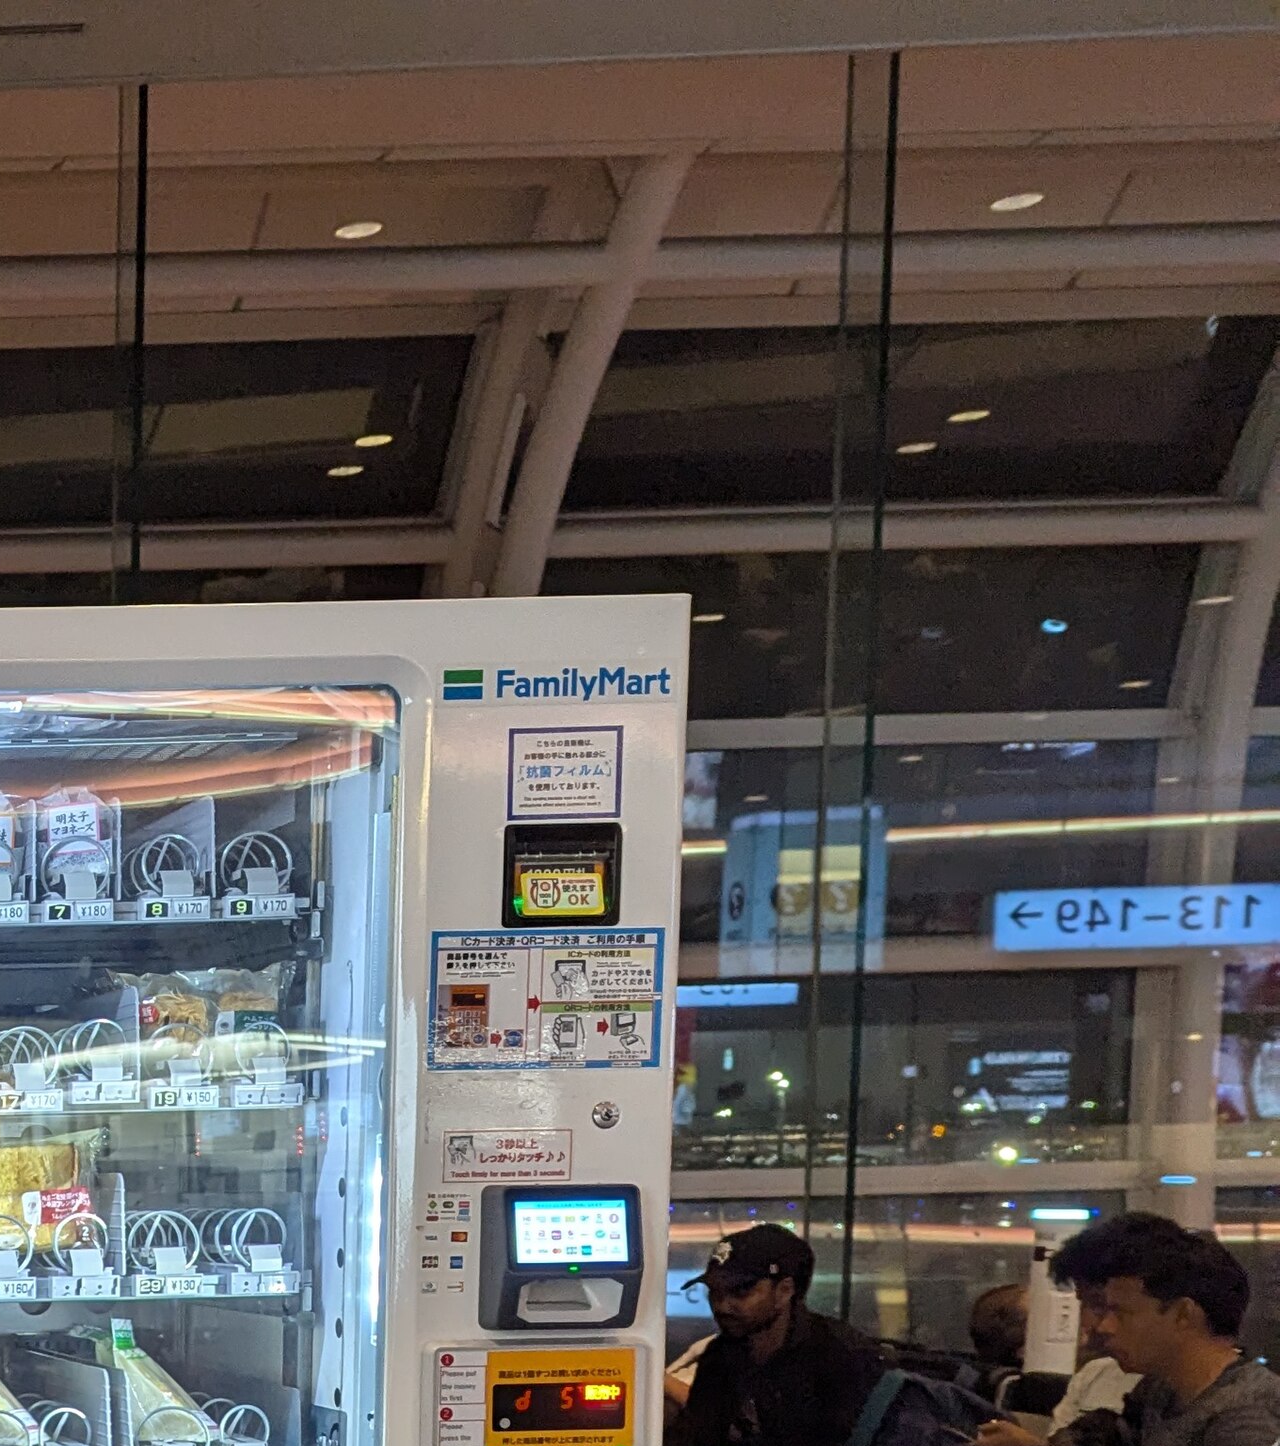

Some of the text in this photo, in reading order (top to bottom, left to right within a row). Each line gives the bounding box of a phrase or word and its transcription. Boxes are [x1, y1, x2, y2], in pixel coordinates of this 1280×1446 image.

[497, 667, 670, 700] FamilyMart
[55, 811, 90, 824] 明太子
[51, 822, 95, 836] マヨネーズ
[562, 885, 596, 893] 使えます
[568, 894, 589, 905] OK
[236, 900, 288, 913] 9 ¥170
[155, 1091, 211, 1106] 19 ¥150
[141, 1279, 196, 1293] 29 ¥130
